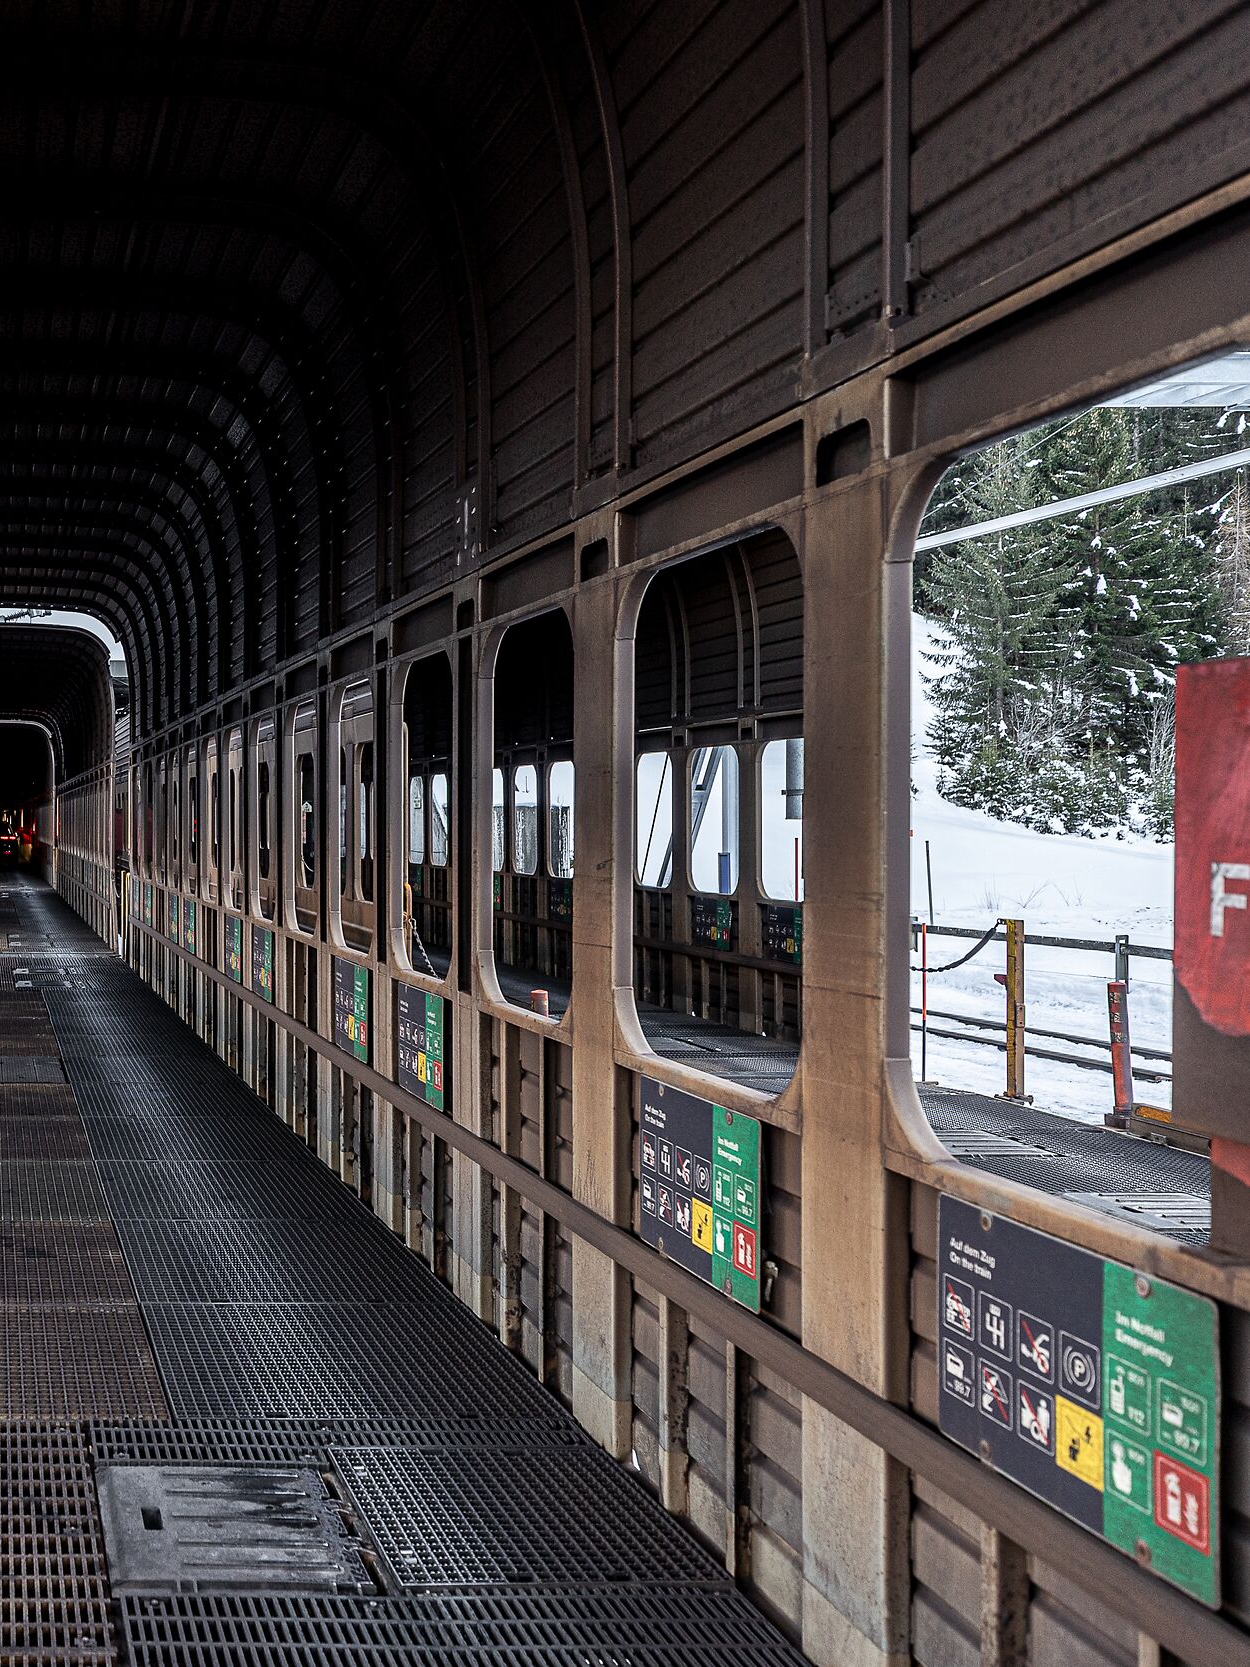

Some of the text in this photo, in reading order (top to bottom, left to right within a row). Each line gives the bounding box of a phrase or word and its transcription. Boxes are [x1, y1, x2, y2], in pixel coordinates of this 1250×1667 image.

[950, 1237, 996, 1269] Auf dem Zug
[950, 1251, 991, 1280] On the train
[1115, 1310, 1165, 1344] Im Notfall
[1115, 1328, 1174, 1367] Emergency
